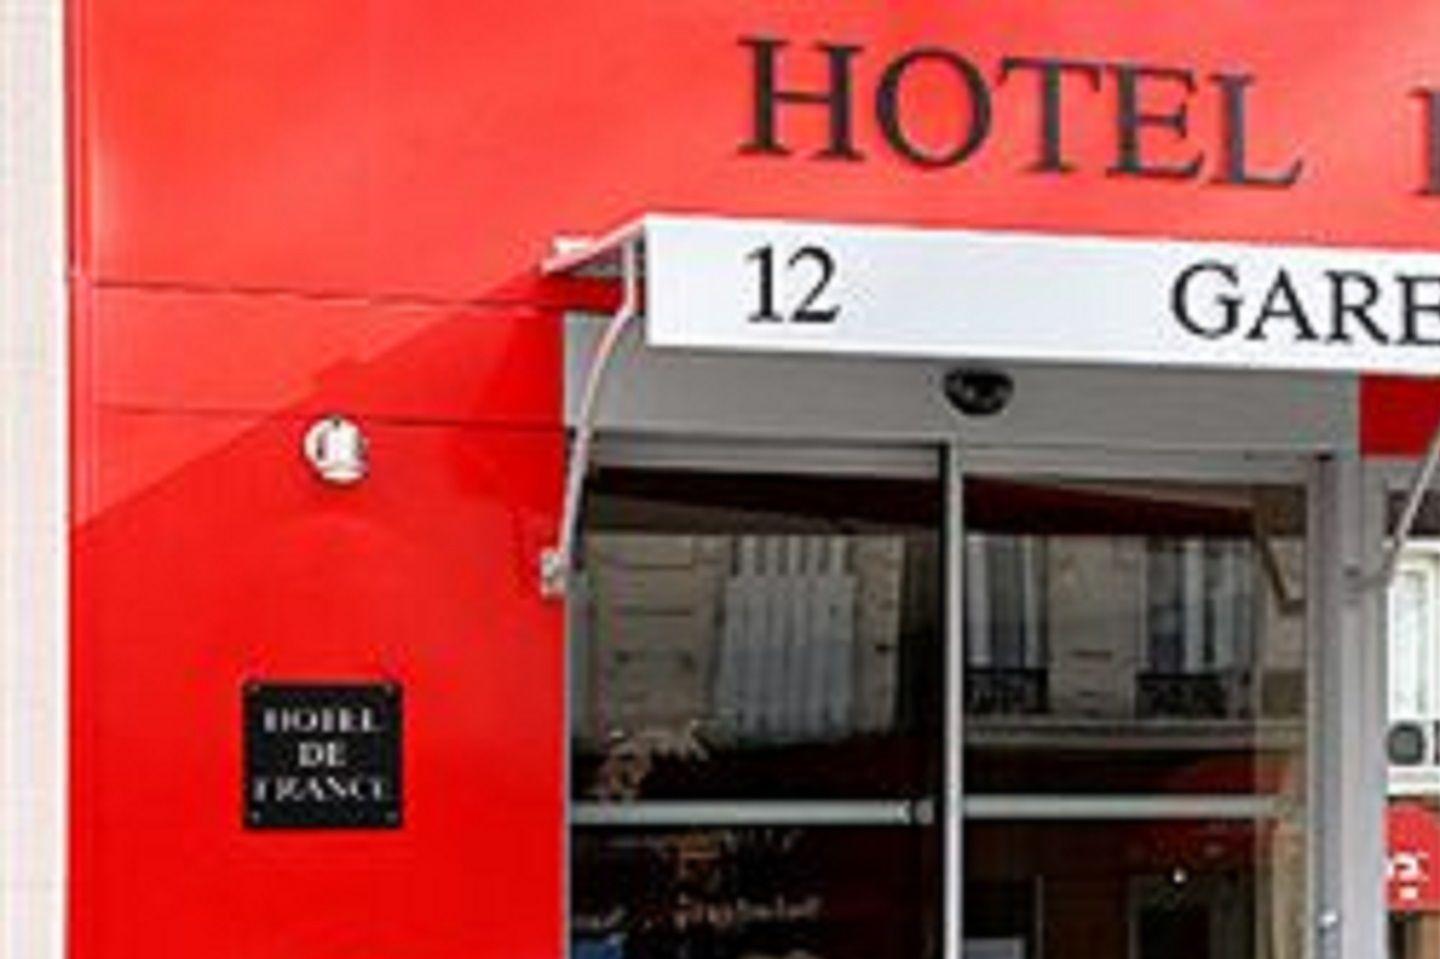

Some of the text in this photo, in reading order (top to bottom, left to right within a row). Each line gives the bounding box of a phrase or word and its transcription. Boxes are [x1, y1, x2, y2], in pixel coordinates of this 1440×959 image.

[738, 36, 1306, 190] HOTEL
[745, 245, 841, 325] 12
[263, 707, 384, 733] HOTEL
[298, 741, 347, 767] DE
